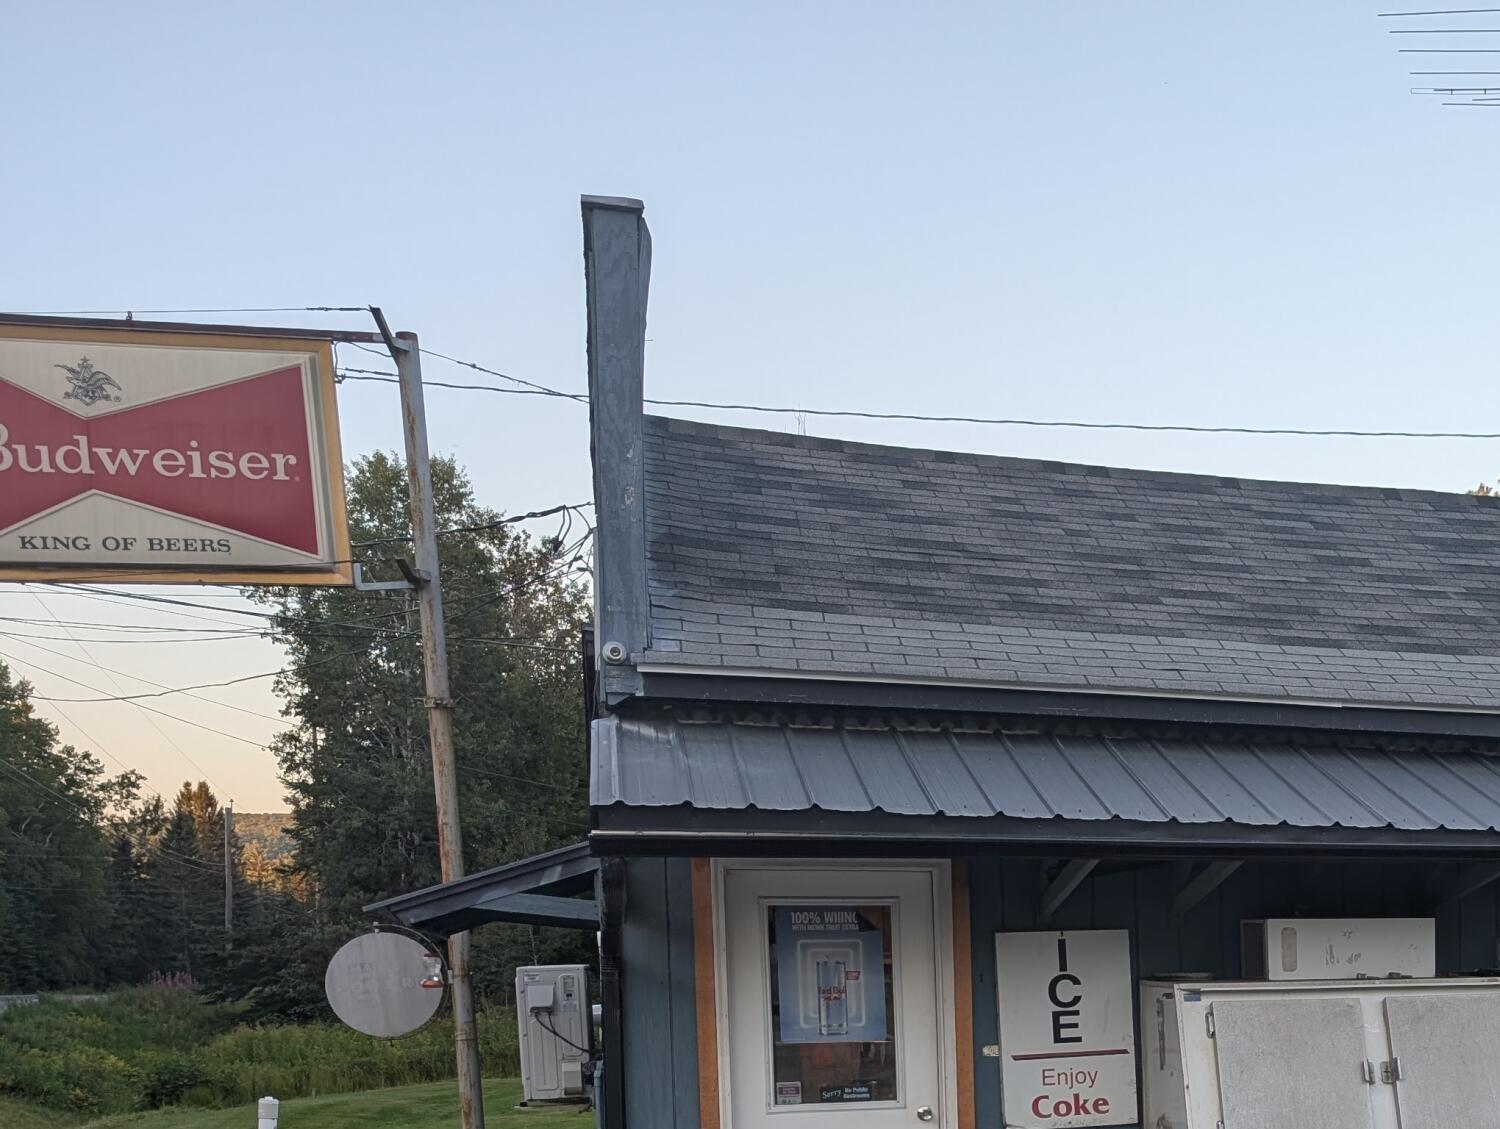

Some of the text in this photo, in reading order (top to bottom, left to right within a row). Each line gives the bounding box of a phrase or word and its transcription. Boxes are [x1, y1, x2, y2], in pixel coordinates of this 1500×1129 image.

[18, 535, 232, 553] KING OF BEERS
[790, 911, 821, 924] 100%
[1048, 938, 1082, 1044] ICE
[1041, 1067, 1099, 1090] Enjoy
[1031, 1093, 1110, 1119] Coke
